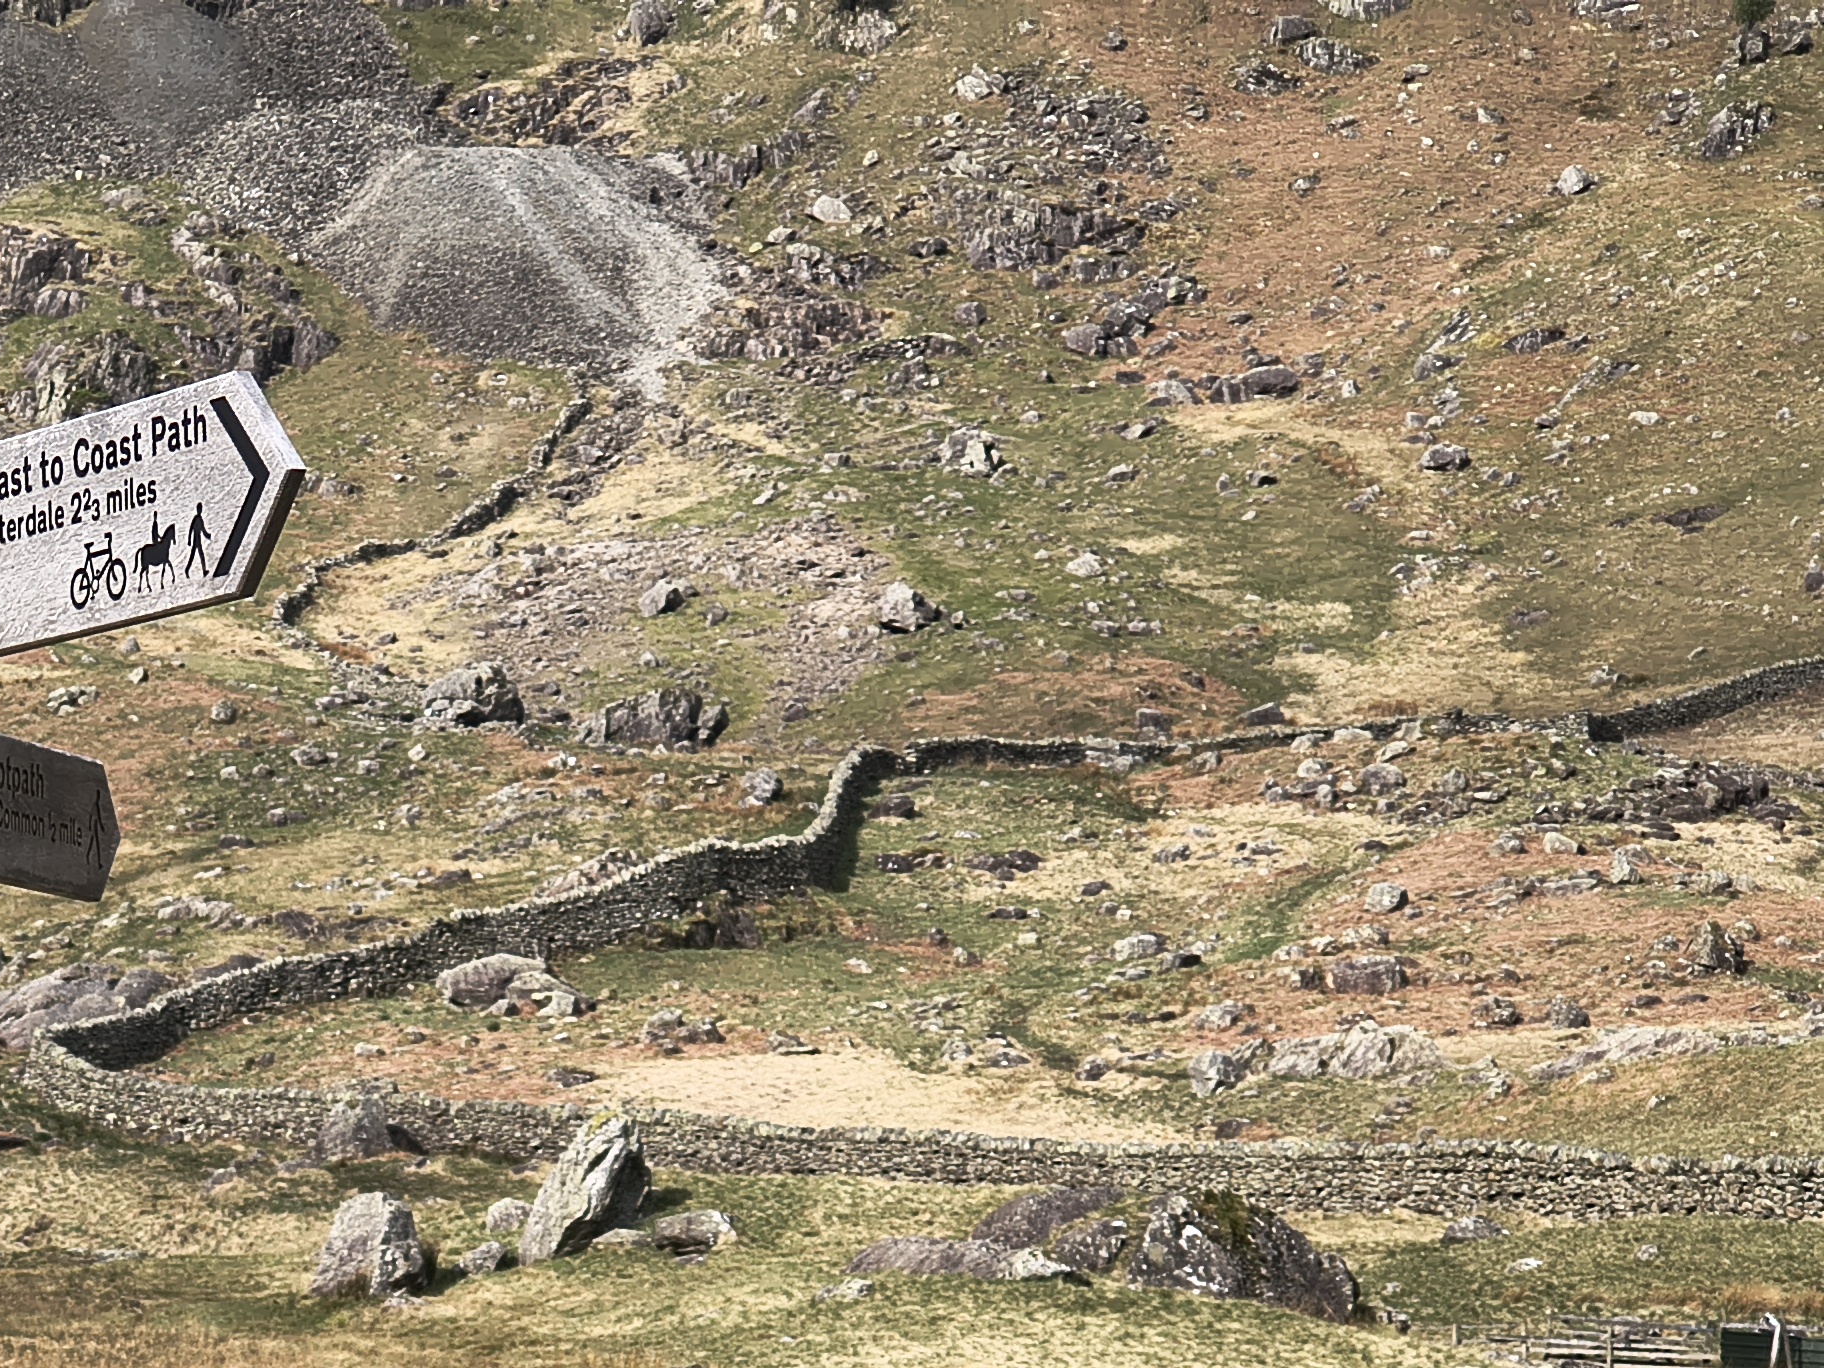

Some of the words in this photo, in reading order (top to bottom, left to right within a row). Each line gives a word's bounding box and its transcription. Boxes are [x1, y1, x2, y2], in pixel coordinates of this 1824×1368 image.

[40, 451, 64, 488] to
[73, 423, 143, 478] Coast
[151, 404, 207, 457] Path
[106, 477, 157, 516] miles
[59, 816, 83, 847] mile
